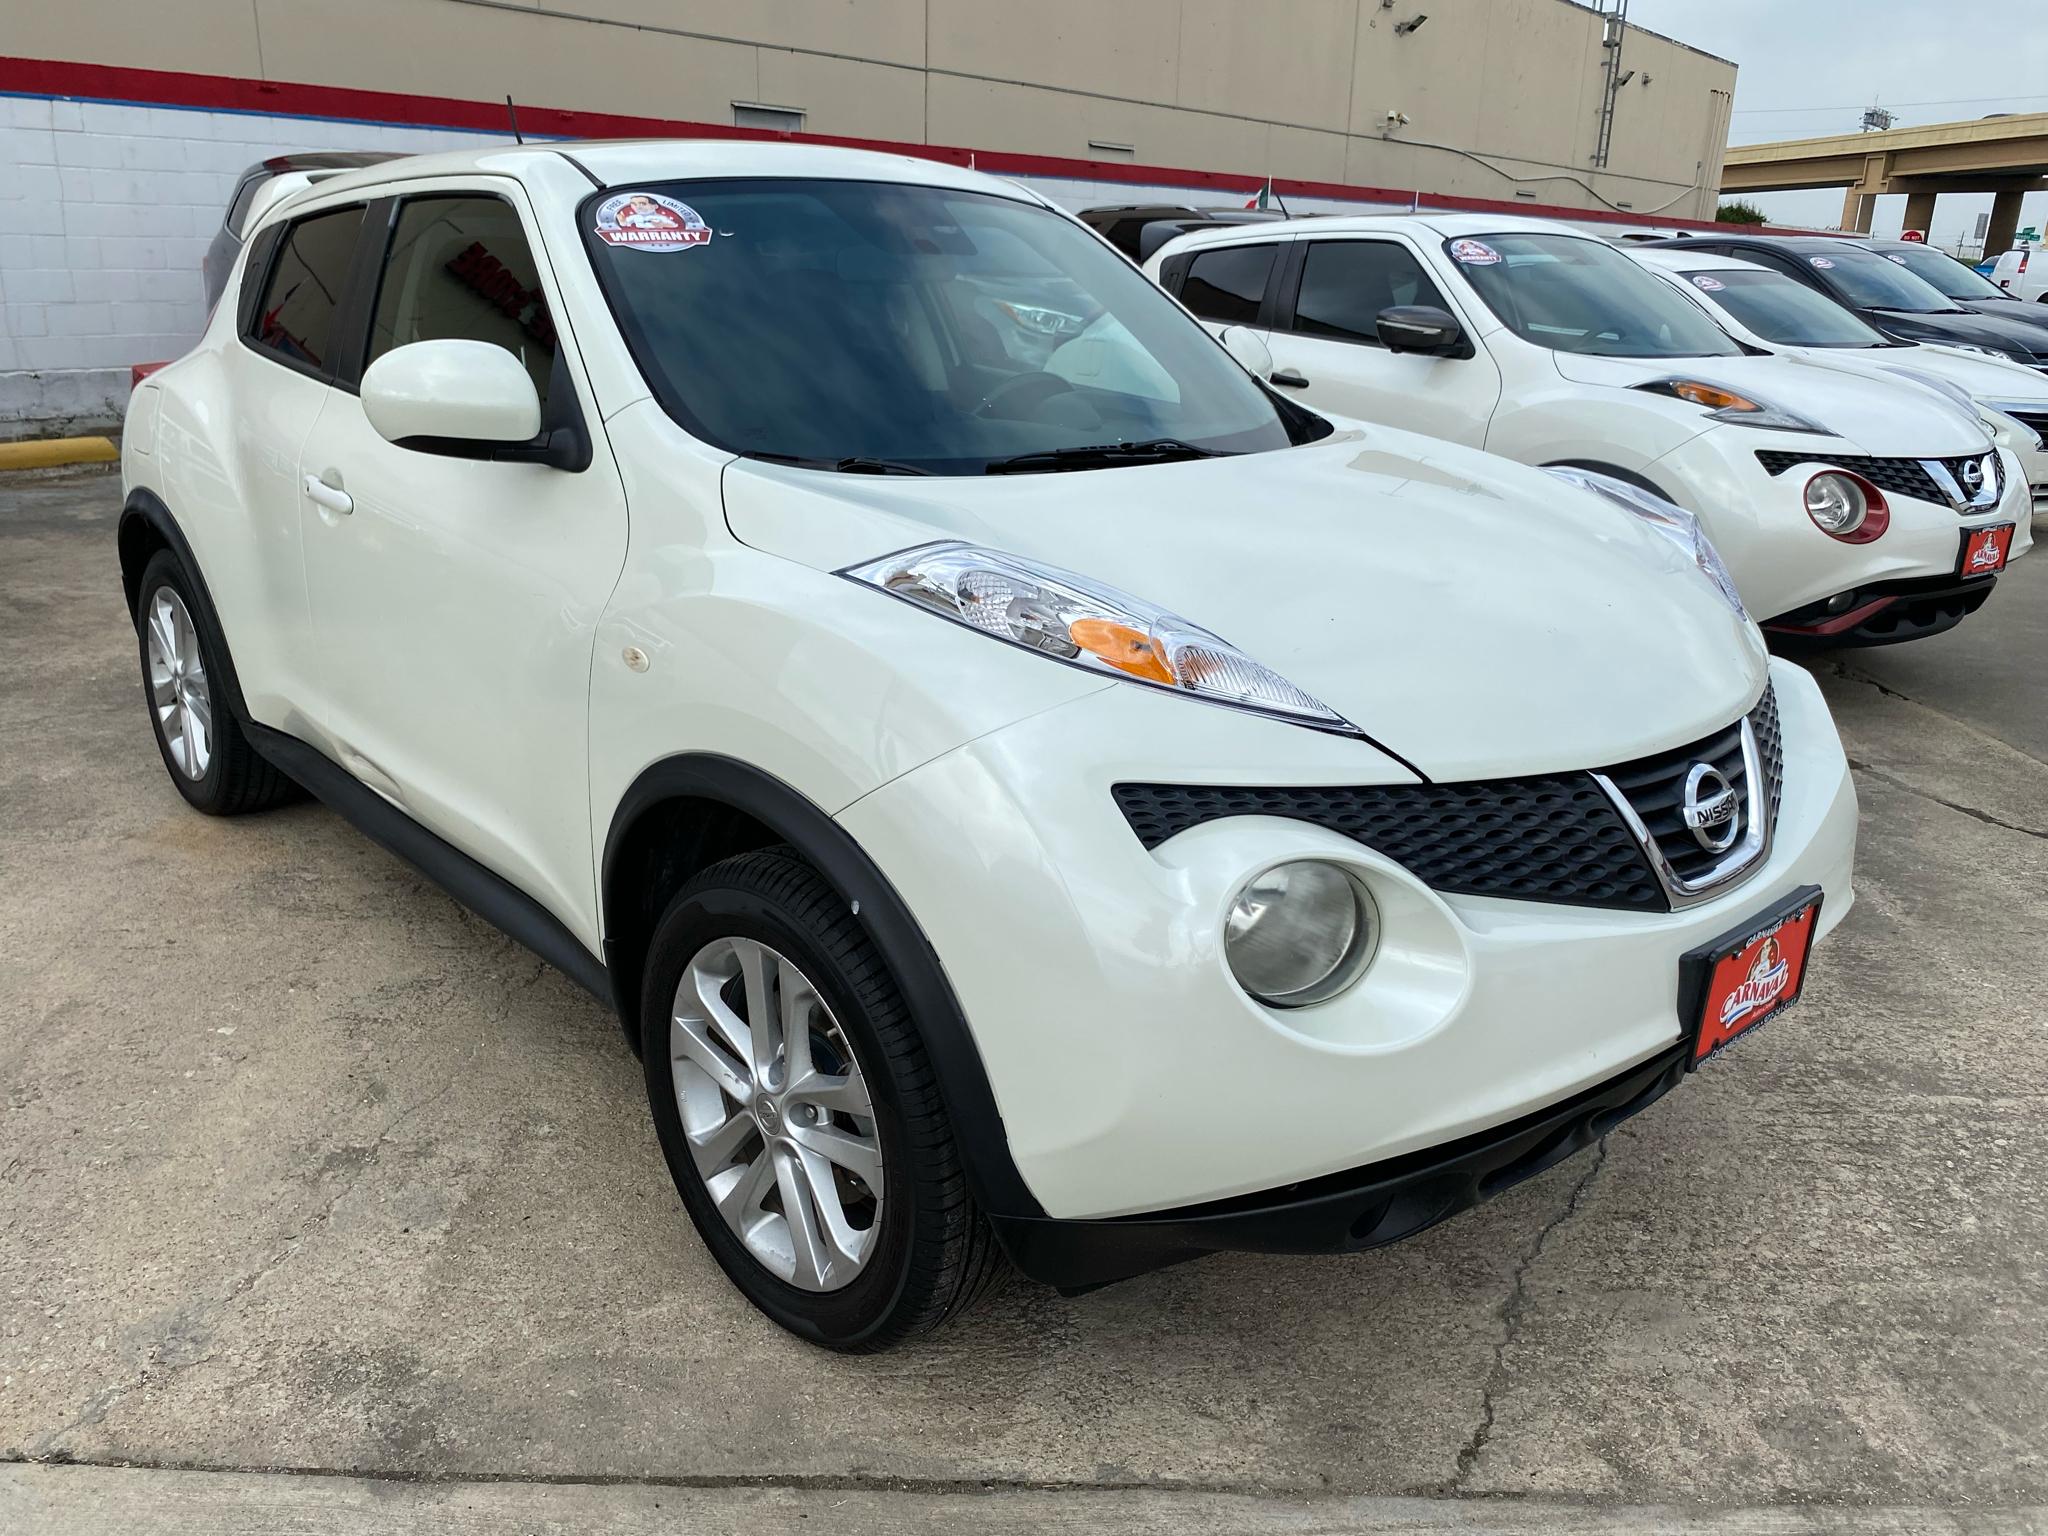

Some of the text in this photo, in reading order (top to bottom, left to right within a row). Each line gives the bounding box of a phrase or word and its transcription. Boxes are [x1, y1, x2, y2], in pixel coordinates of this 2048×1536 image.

[606, 199, 692, 217] FREE LIMITED
[609, 231, 702, 242] WARRANTY
[1721, 966, 1788, 1016] CARNAVAL
